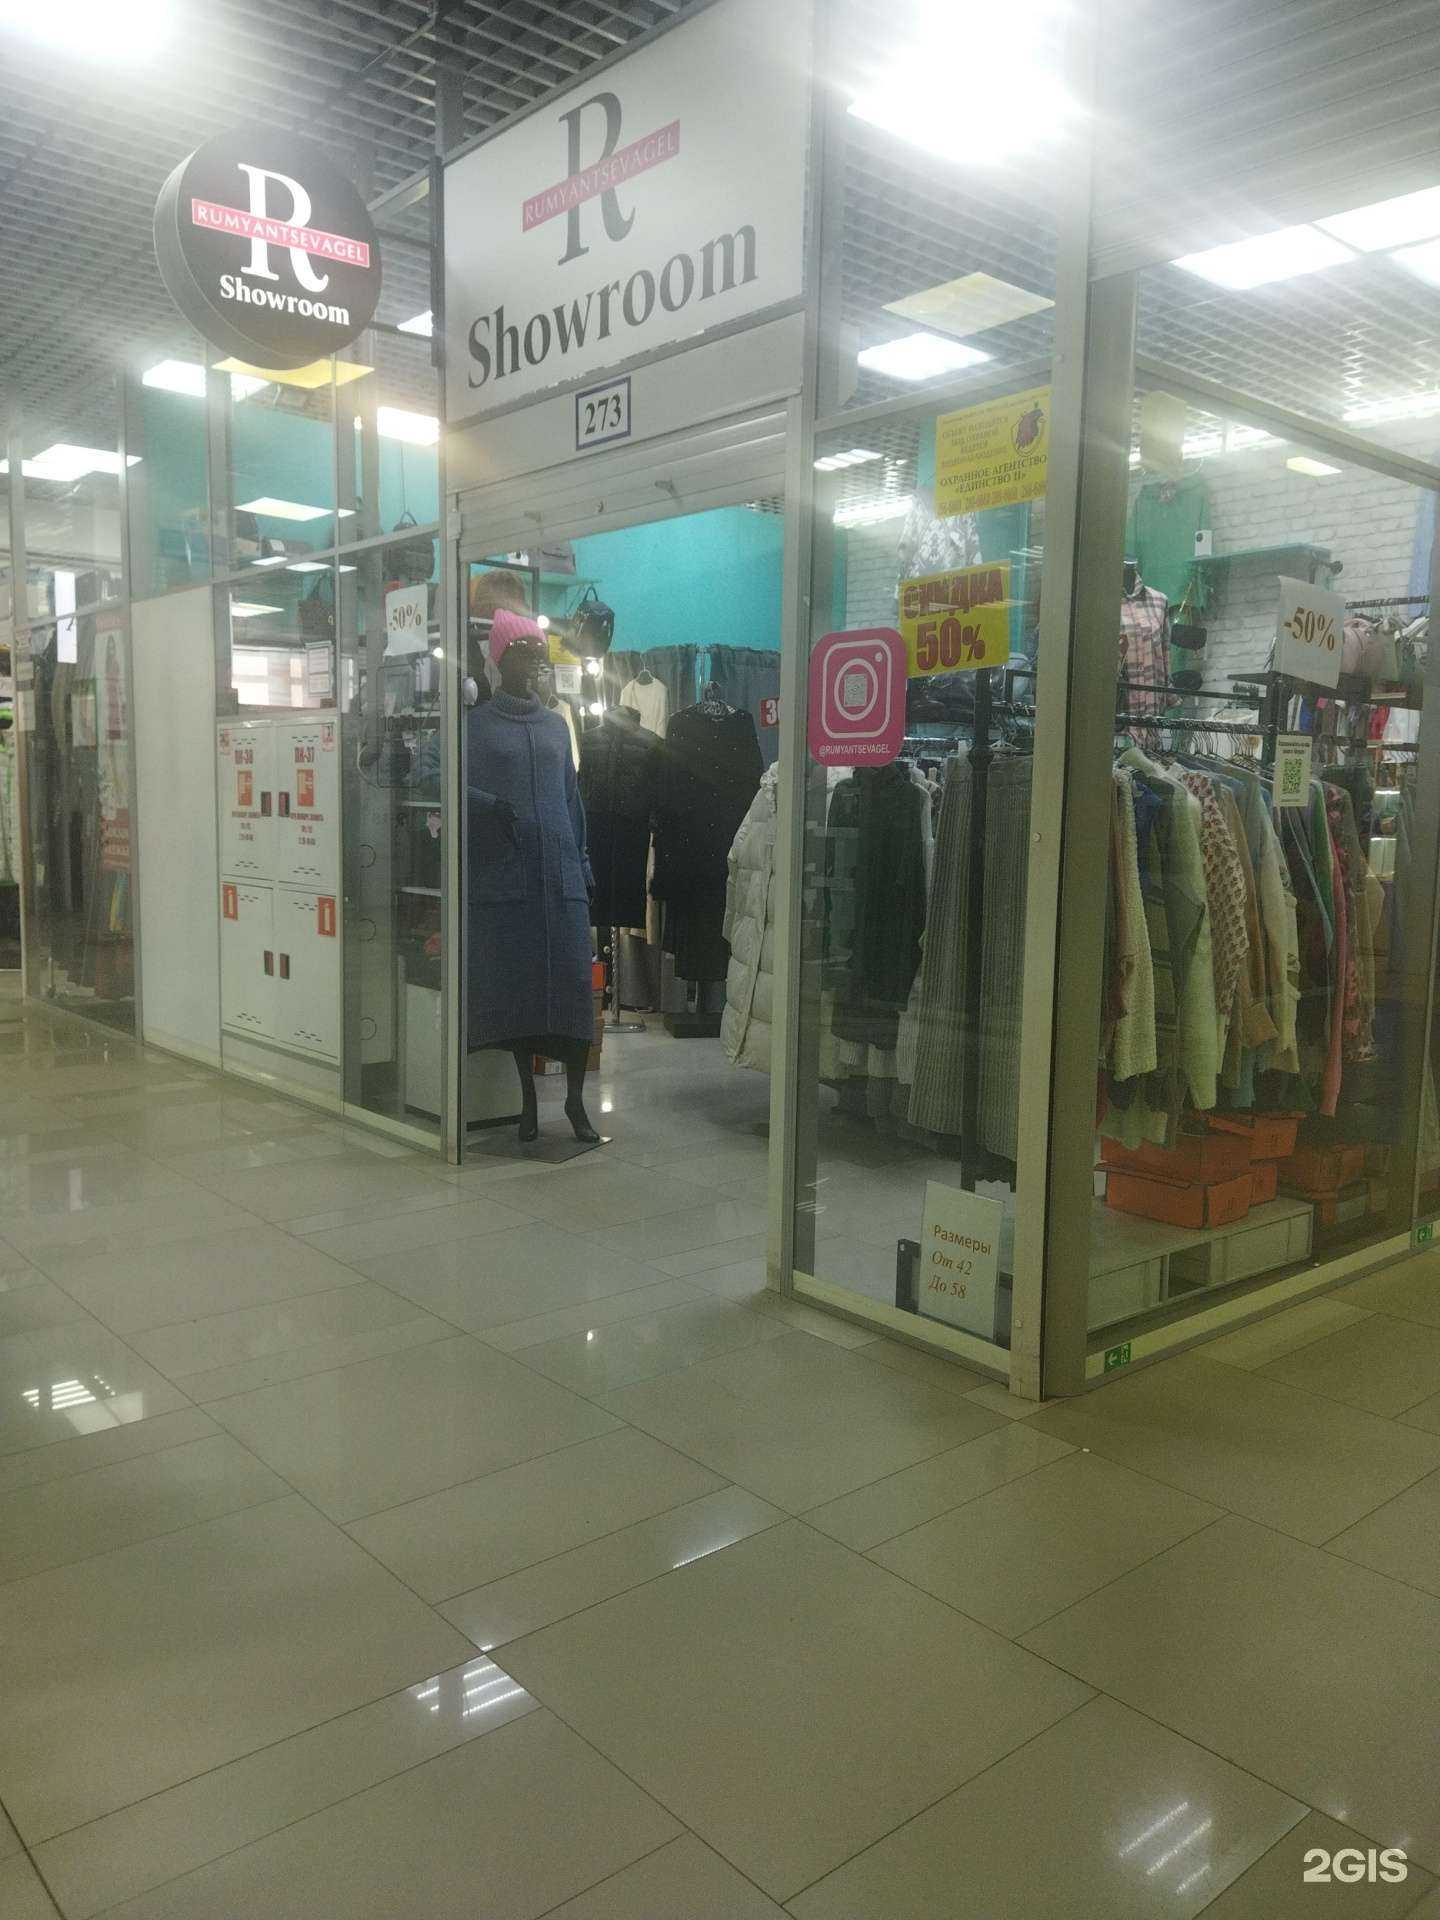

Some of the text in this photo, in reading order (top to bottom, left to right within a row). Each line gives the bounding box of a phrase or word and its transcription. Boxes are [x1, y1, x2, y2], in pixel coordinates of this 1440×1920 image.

[525, 130, 676, 225] RUMYANTSEVAGEL
[558, 92, 636, 266] R
[197, 205, 365, 262] RUMYANTSEVAGEL
[238, 163, 329, 293] R
[219, 274, 350, 326] Showroom
[467, 224, 759, 389] Showroom
[584, 393, 622, 435] 273
[940, 466, 992, 487] ОХРАННОЕ
[389, 603, 422, 631] -50%
[903, 570, 1003, 619] СКИДКА
[916, 617, 986, 670] 50%
[1284, 607, 1335, 651] -50%
[818, 743, 890, 757] @RUMYANTSEVAGEL
[932, 1250, 973, 1275] От 42
[933, 1224, 992, 1255] Размеры
[928, 1274, 967, 1299] До 58
